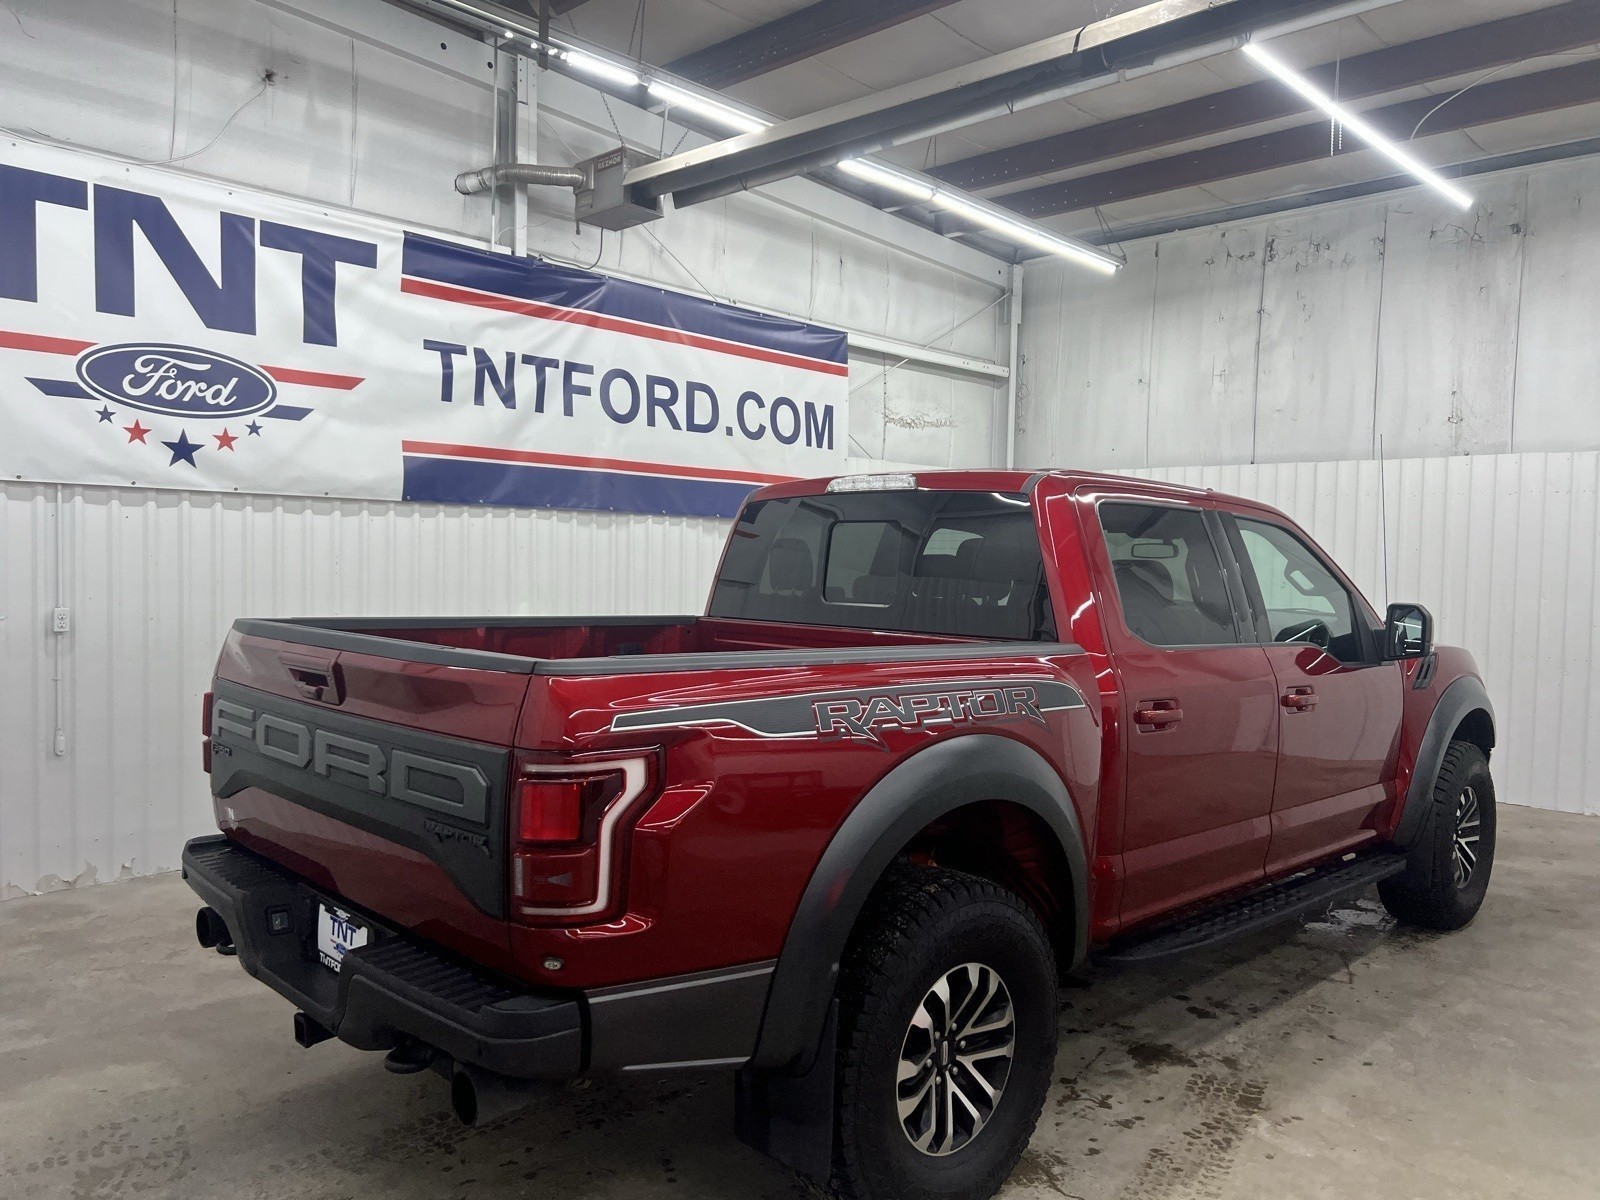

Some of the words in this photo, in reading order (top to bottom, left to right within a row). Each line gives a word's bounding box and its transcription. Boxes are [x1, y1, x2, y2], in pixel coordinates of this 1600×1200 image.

[0, 164, 378, 347] TNT
[122, 354, 239, 408] Ford
[423, 339, 834, 450] TNTFORD.COM
[814, 685, 1047, 743] RAPTOR
[212, 698, 490, 825] FORD
[330, 915, 357, 947] TNT
[319, 951, 342, 973] TNTFO
